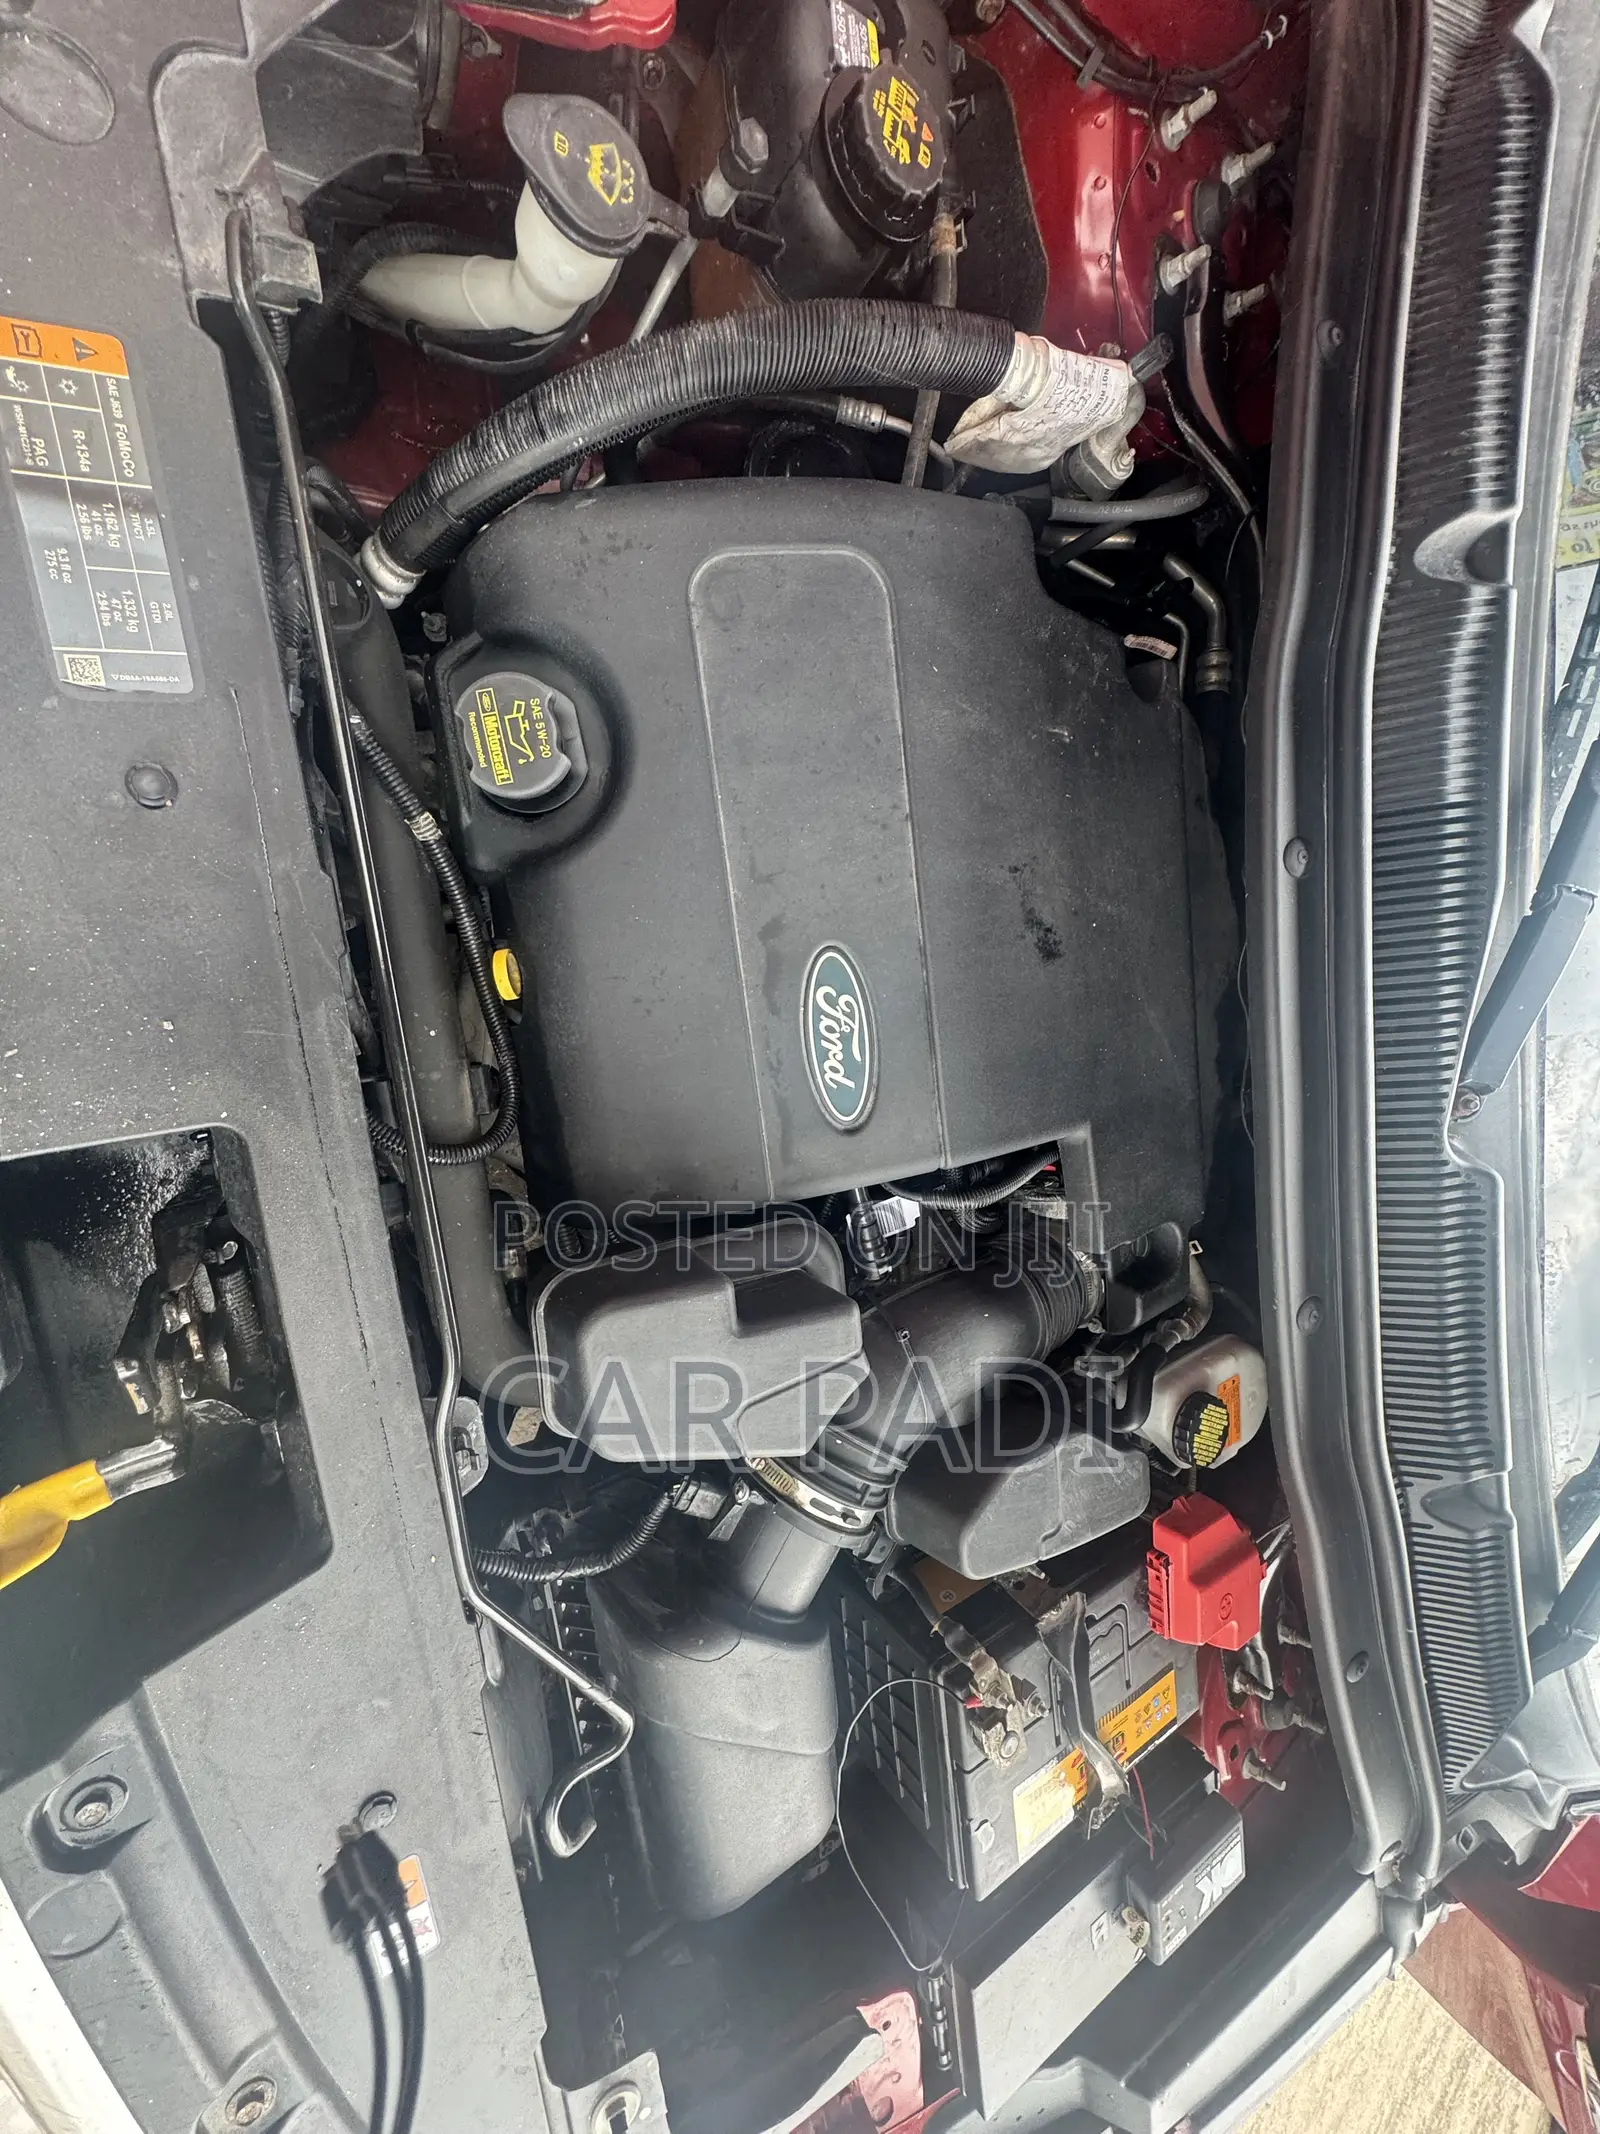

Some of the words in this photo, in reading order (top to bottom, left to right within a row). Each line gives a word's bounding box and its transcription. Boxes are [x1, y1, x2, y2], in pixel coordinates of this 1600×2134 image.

[105, 377, 121, 397] SAE
[1102, 368, 1110, 388] NOT
[109, 397, 124, 419] J639
[31, 437, 48, 467] PAG
[70, 429, 91, 473] R-134a
[113, 423, 135, 478] FoMoCo
[75, 503, 90, 525] 2.56
[91, 509, 102, 523] 41
[101, 502, 118, 532] 1.162
[79, 525, 94, 541] lbs
[94, 522, 105, 536] oz
[143, 518, 156, 539] 3.5L
[106, 533, 122, 548] kg
[45, 549, 59, 568] 275
[56, 547, 70, 563] 9.3
[48, 568, 60, 580] cc
[61, 571, 74, 584] oz
[95, 591, 109, 611] 2.94
[110, 597, 122, 610] 47
[121, 589, 136, 617] 1.332
[100, 611, 113, 627] lbs
[113, 610, 125, 623] oz
[161, 602, 175, 622] 2.0L
[125, 617, 141, 633] kg
[530, 698, 544, 720] SAE
[468, 711, 487, 768] Recommended
[484, 716, 511, 783] Motorcraft
[815, 985, 862, 1090] Ford
